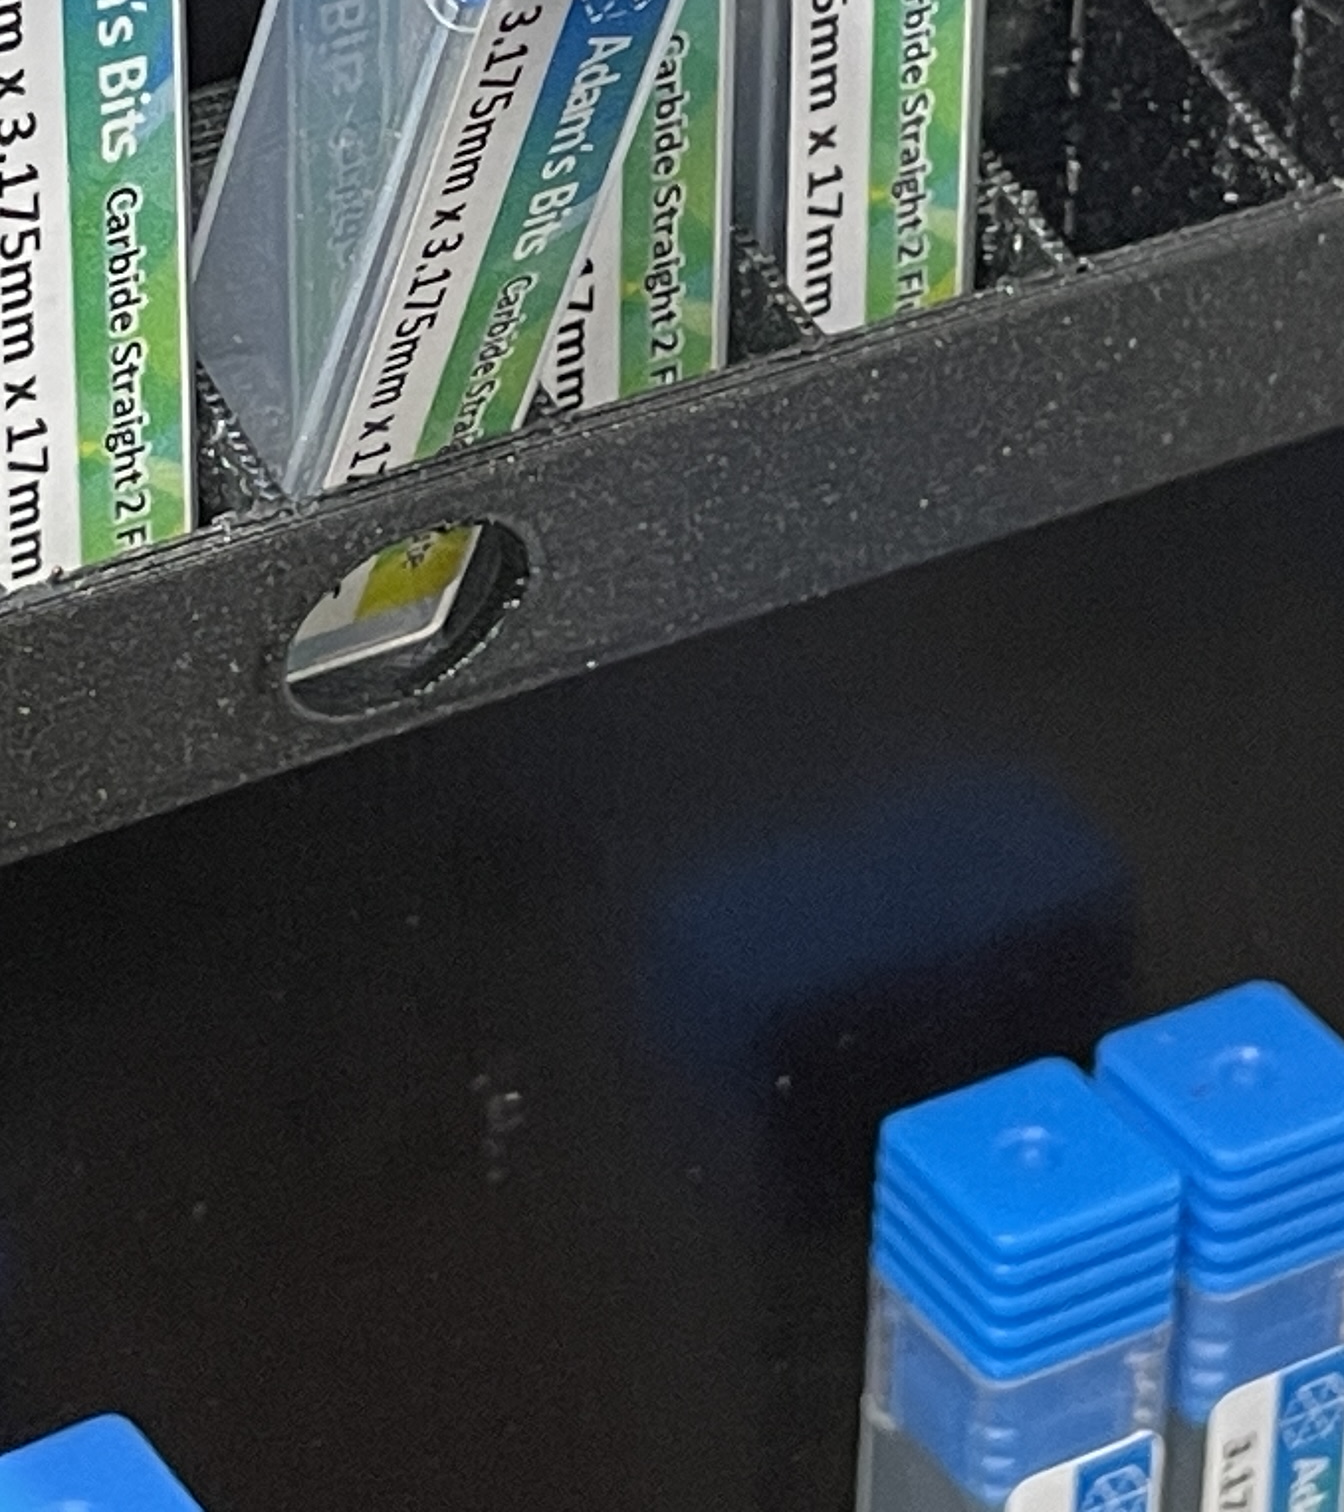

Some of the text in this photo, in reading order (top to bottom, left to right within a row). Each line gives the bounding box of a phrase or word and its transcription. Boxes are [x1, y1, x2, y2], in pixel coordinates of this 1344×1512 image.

[97, 54, 152, 164] Bits
[441, 4, 543, 196] 3.175mm
[542, 36, 634, 181] Adam's
[807, 124, 837, 157] x
[428, 201, 467, 231] x
[892, 92, 930, 232] Straight
[106, 187, 144, 333] Carbide
[513, 181, 580, 262] Bits
[645, 183, 684, 325] Straight
[804, 164, 844, 319] 17mm
[897, 237, 925, 265] 2
[368, 232, 465, 410] 3.175mm
[474, 275, 534, 379] Carbide
[651, 330, 679, 359] 2
[2, 375, 38, 411] x
[104, 341, 146, 490] Straight
[358, 414, 395, 441] x
[5, 416, 50, 580] 17mm
[115, 491, 147, 521] 2
